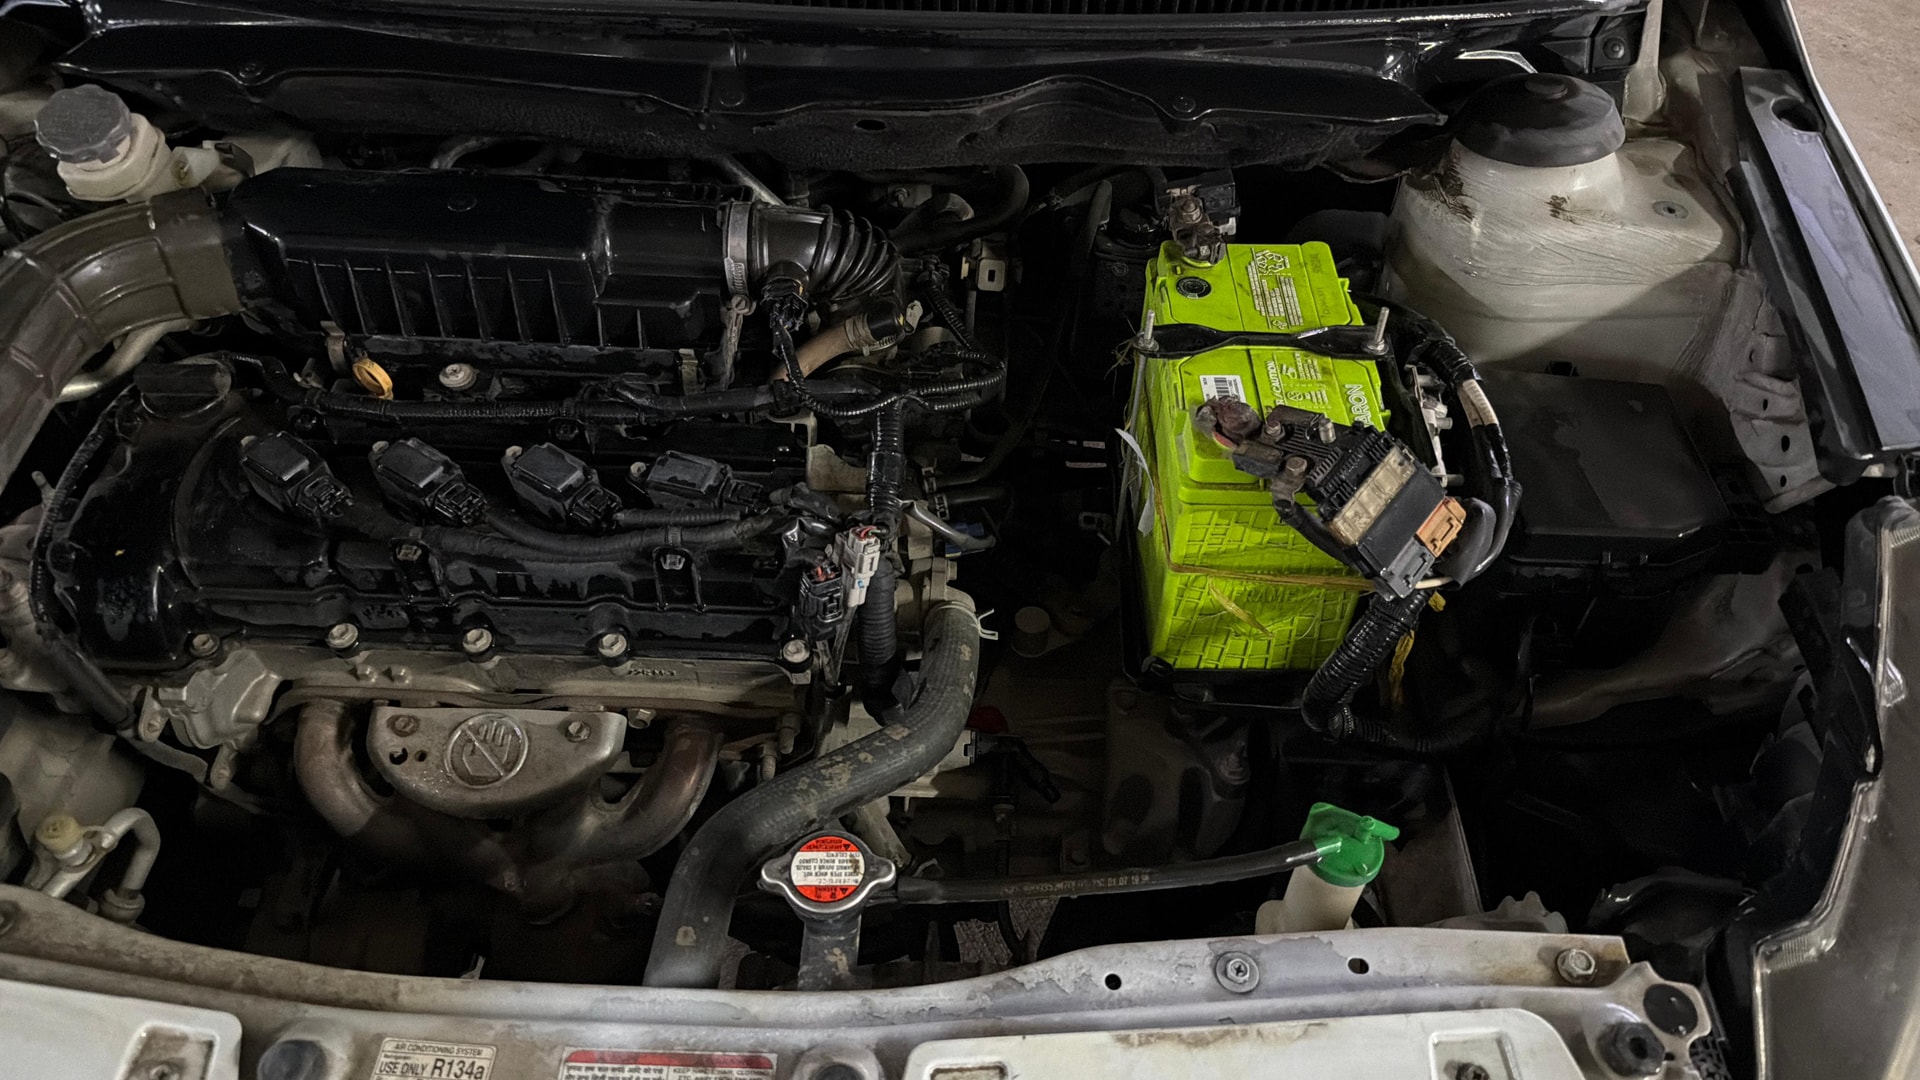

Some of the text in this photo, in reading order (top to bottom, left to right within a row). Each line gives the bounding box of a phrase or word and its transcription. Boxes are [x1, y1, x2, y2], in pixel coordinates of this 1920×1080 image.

[407, 1044, 454, 1054] CONDITIONING
[456, 1047, 483, 1056] SYSTEM
[379, 1060, 400, 1074] USE
[401, 1062, 429, 1075] ONLY
[431, 1058, 485, 1080] R134a
